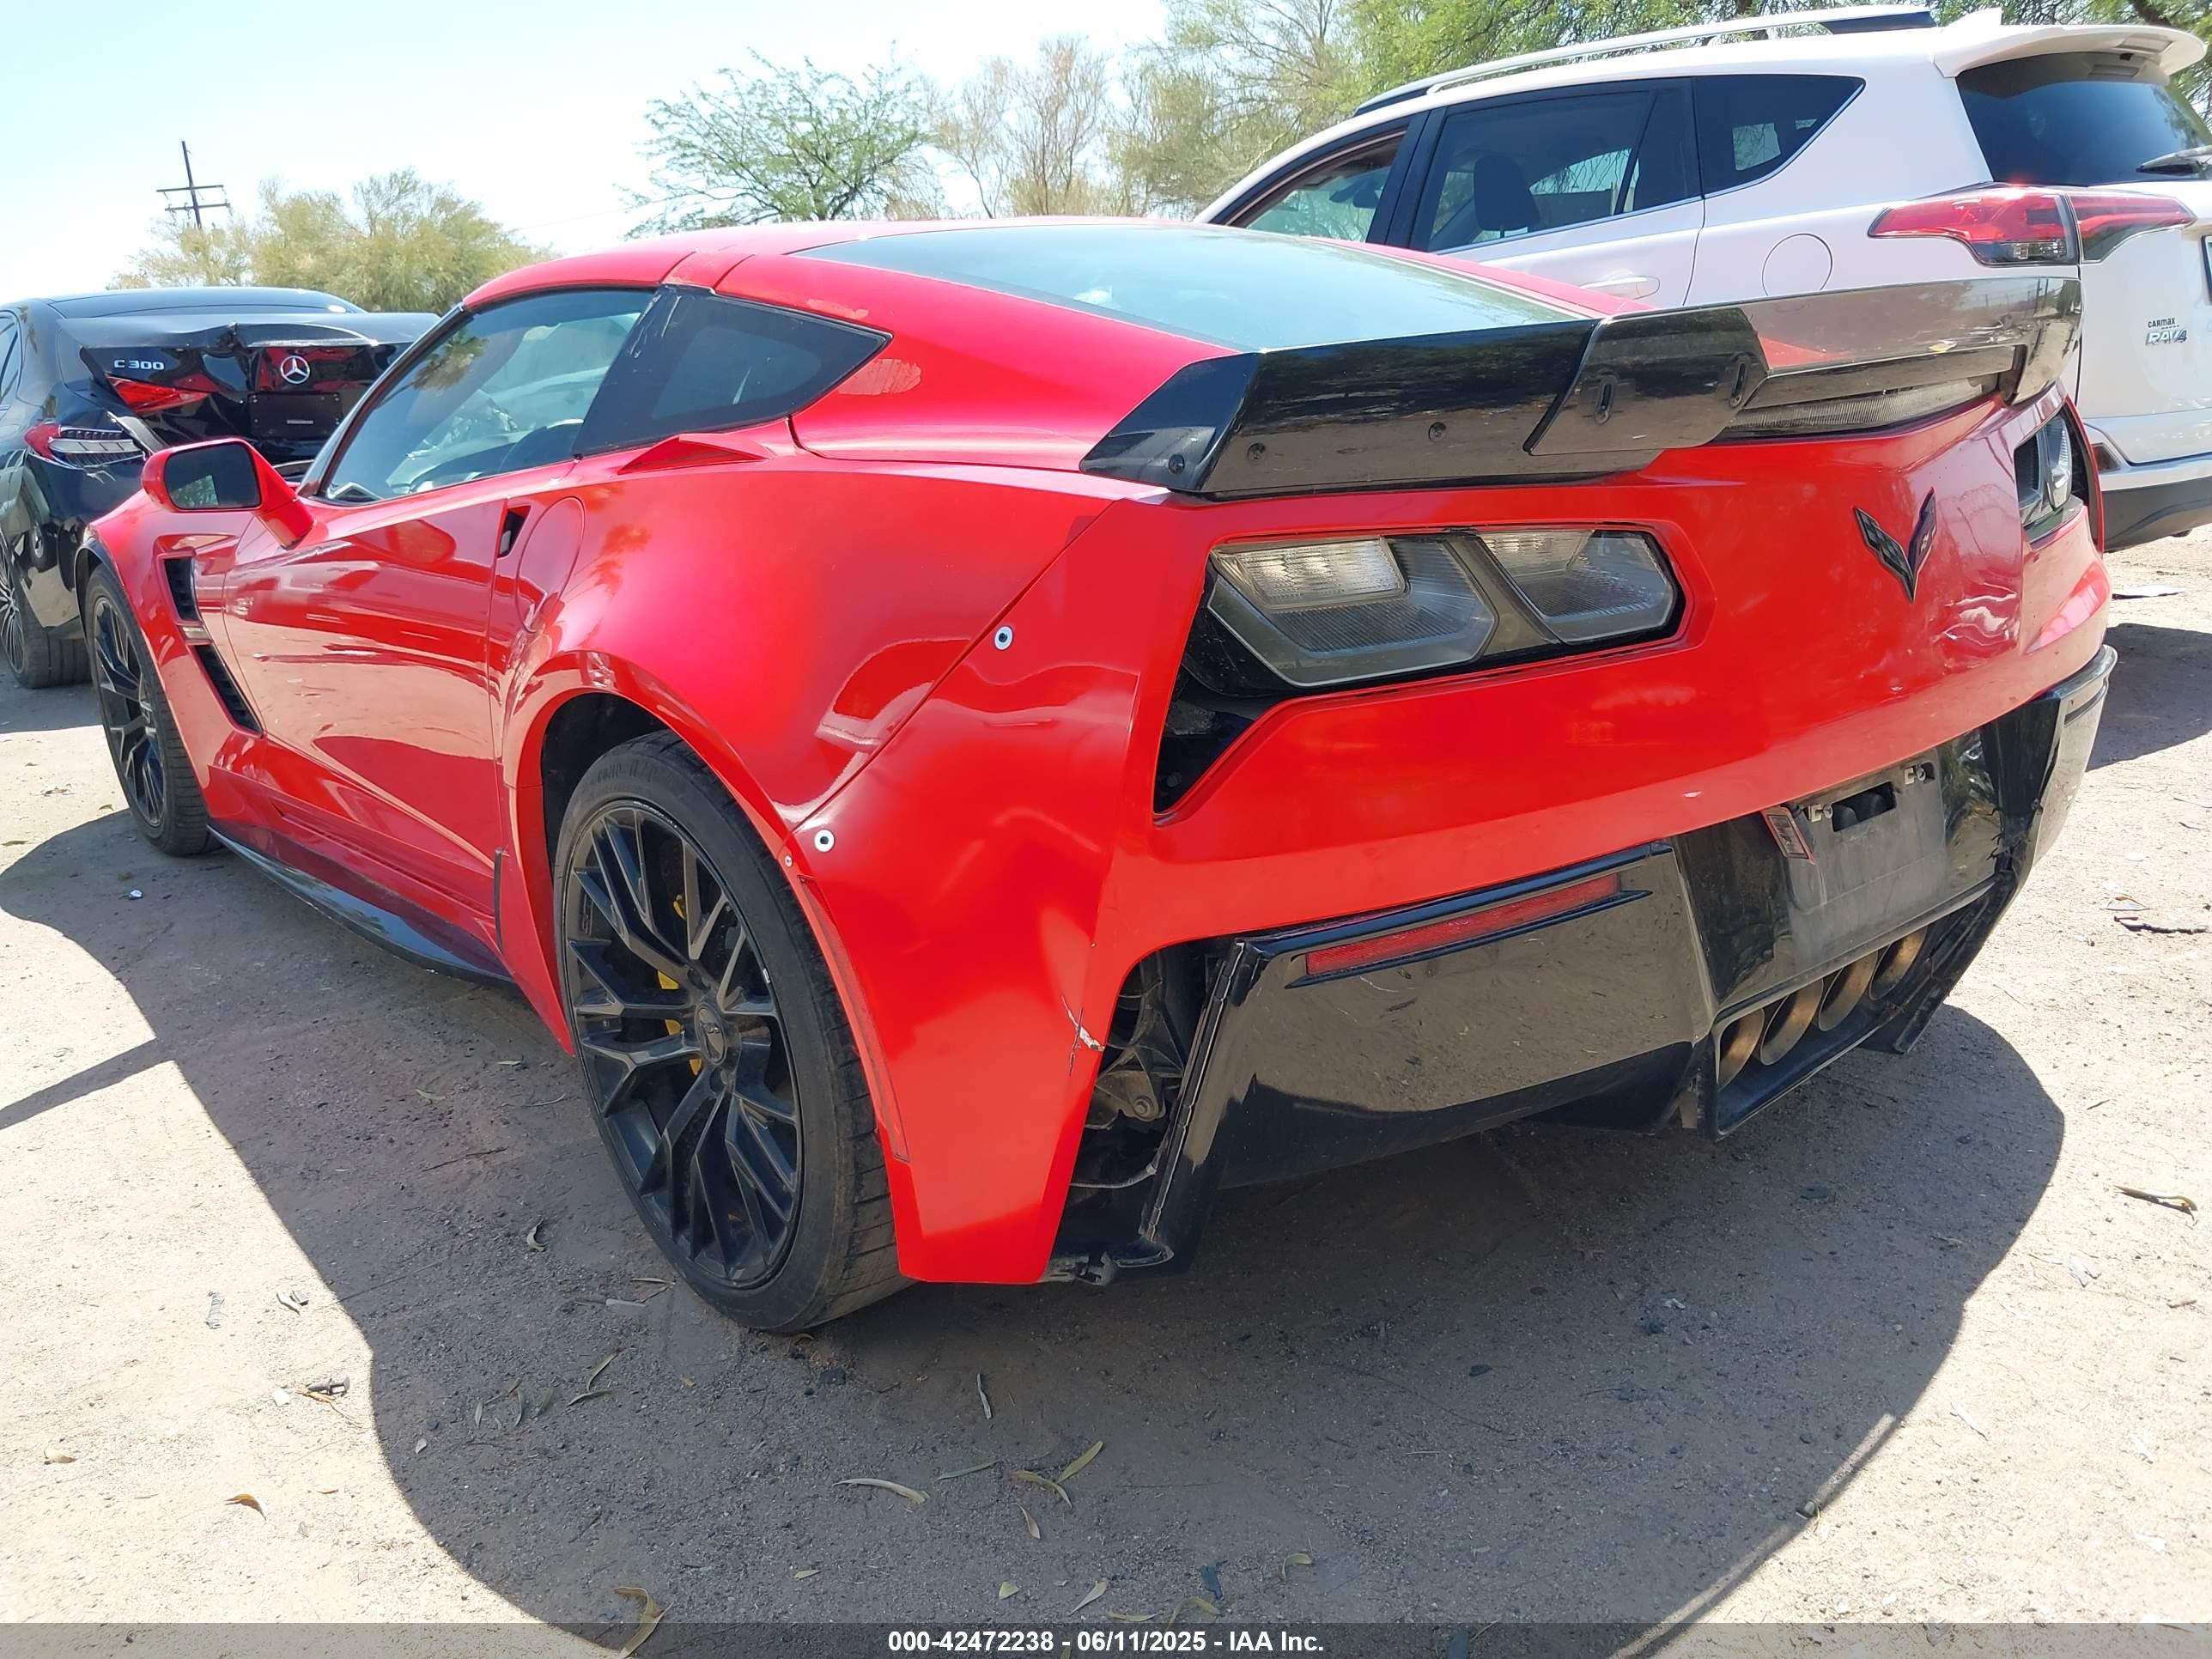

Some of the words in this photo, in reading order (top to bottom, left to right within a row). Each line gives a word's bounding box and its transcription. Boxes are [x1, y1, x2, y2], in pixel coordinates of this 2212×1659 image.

[2145, 329, 2187, 345] RAV4
[113, 359, 125, 368] C
[128, 360, 165, 370] 300
